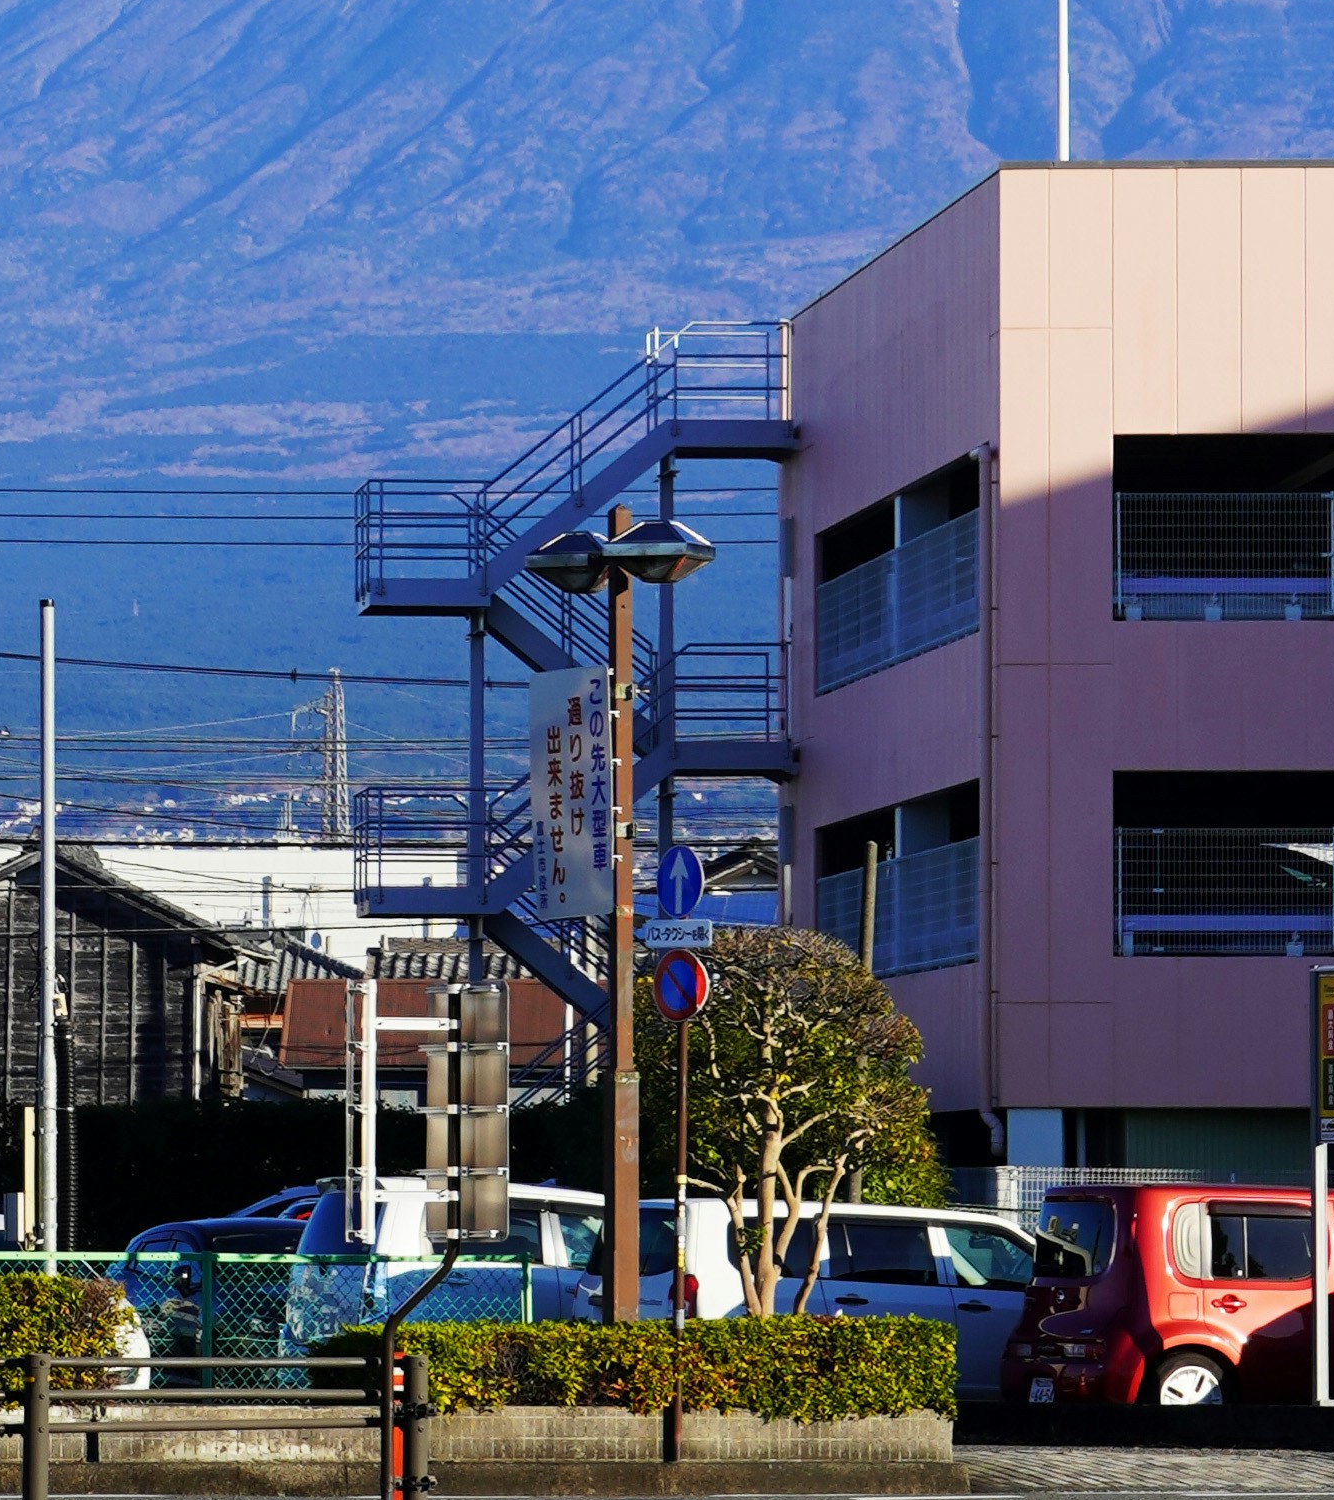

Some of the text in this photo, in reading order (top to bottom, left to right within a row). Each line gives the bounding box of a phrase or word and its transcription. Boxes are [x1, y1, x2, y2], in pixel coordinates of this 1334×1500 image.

[547, 725, 566, 903] 出来ません。
[567, 696, 585, 836] 通り抜け
[589, 678, 608, 872] この先大型車
